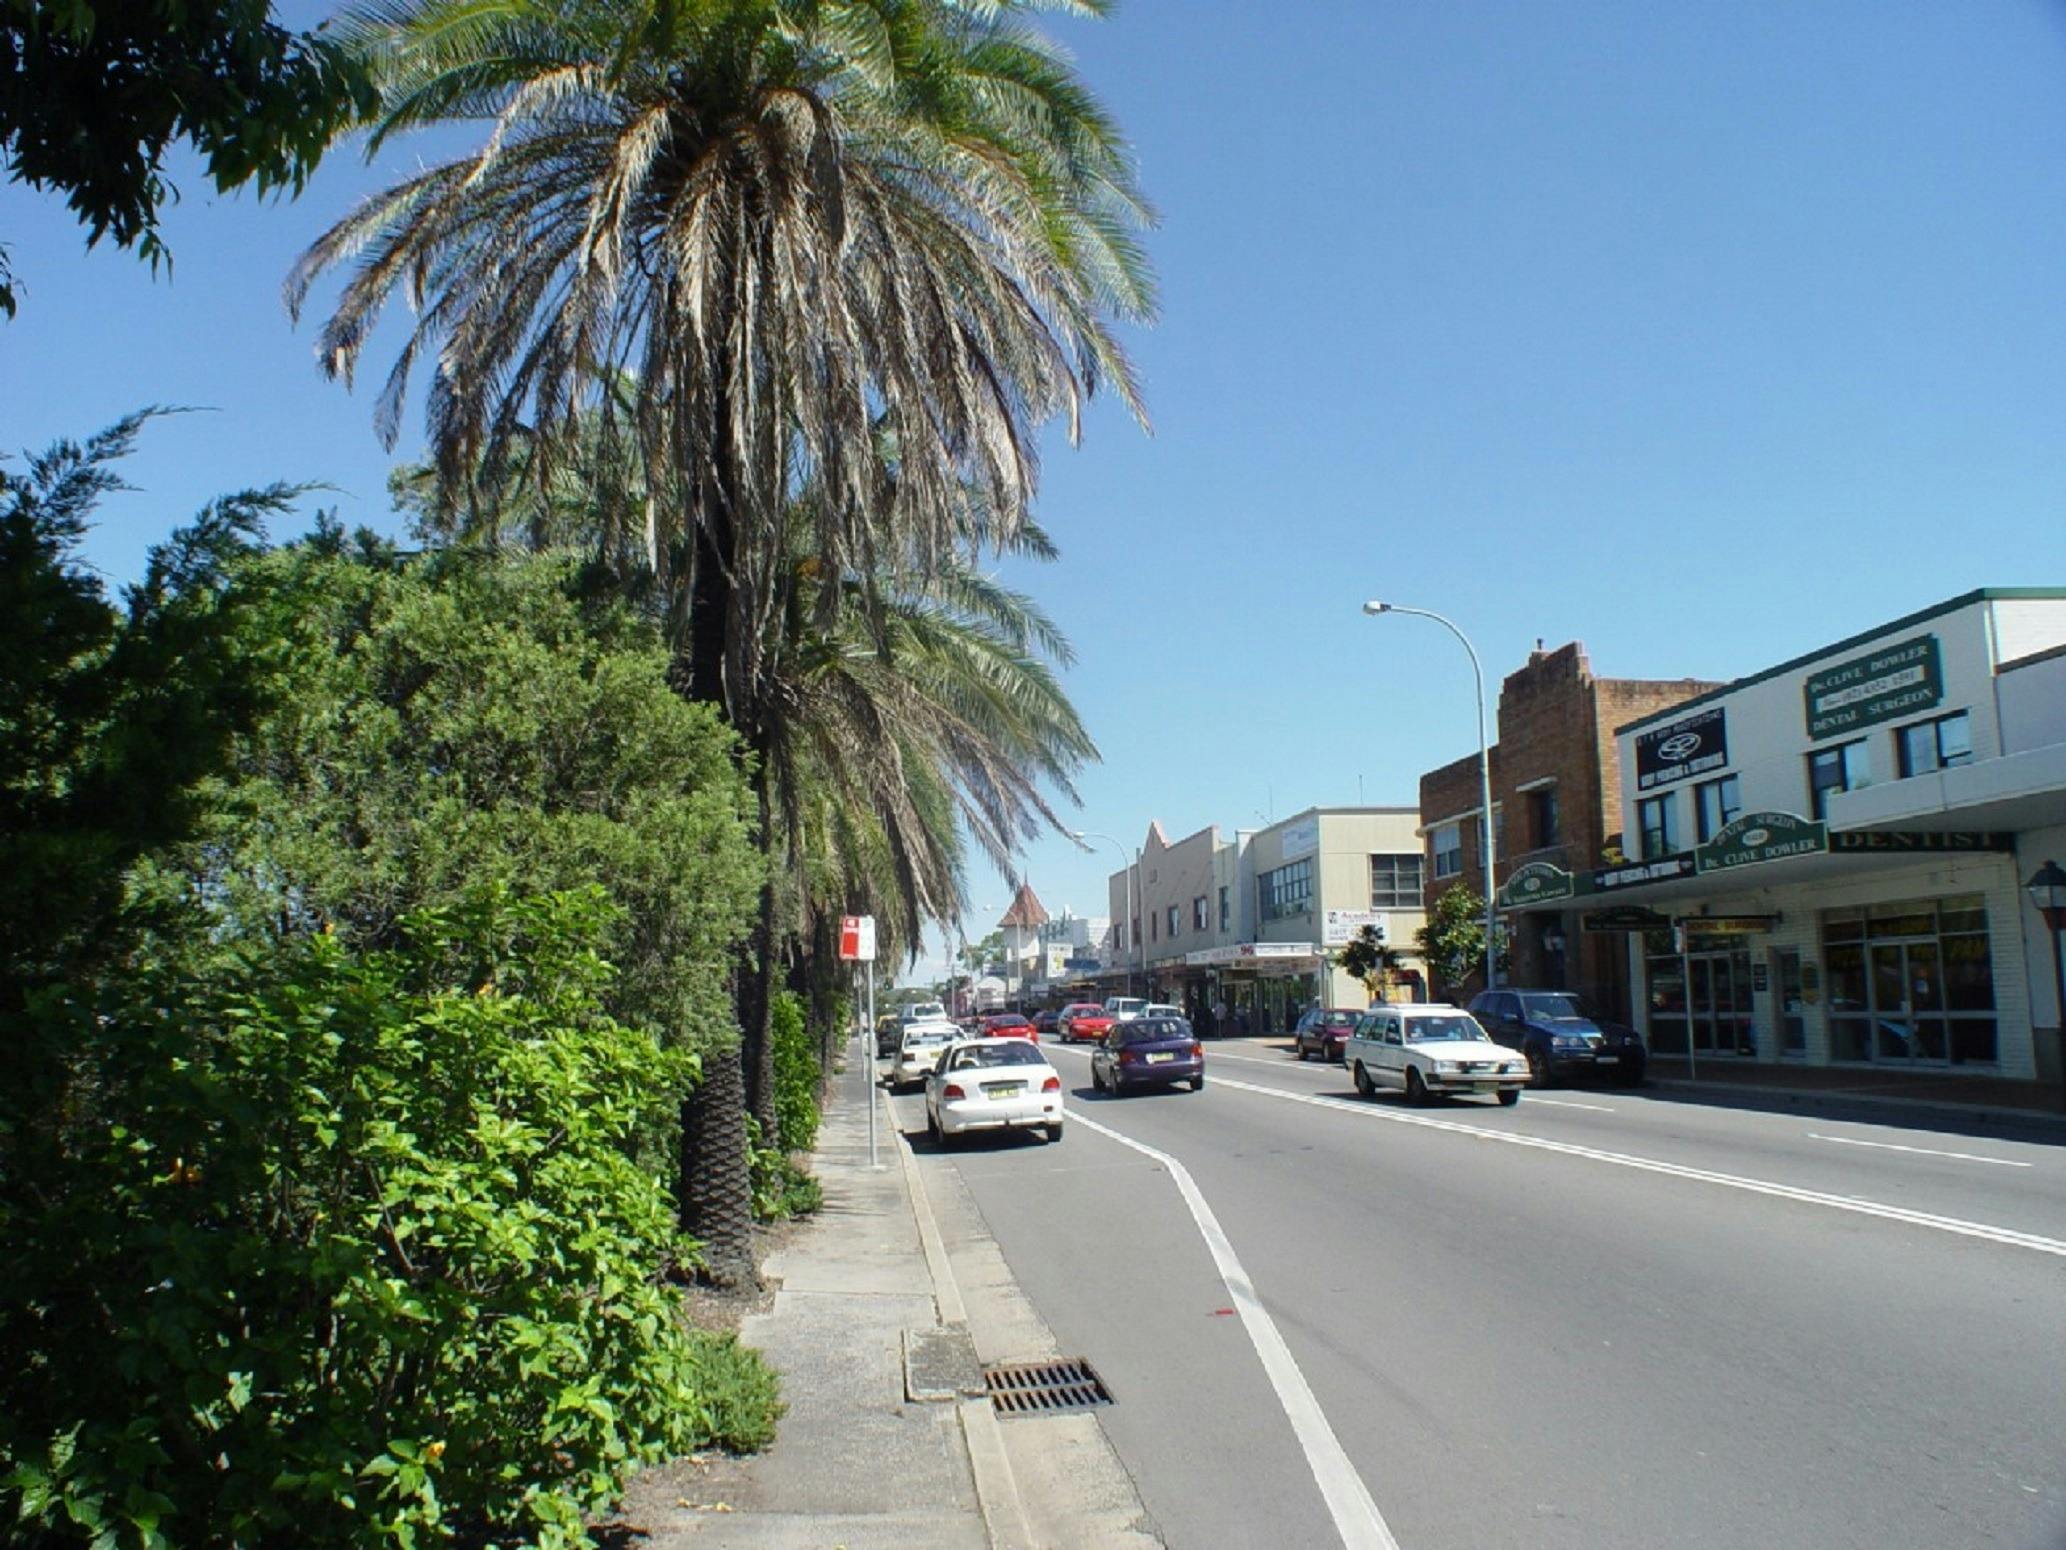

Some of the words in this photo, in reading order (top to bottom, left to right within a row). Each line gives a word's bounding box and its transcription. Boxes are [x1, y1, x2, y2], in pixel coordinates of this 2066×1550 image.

[1826, 668, 1864, 688] CLIVE
[1870, 645, 1928, 673] DOWLER
[1813, 710, 1857, 732] DENTAL
[1867, 688, 1933, 715] SURGEON
[1724, 850, 1758, 864] CLIVE
[1765, 839, 1817, 858] DOWLER
[1840, 831, 1996, 847] DENTIST
